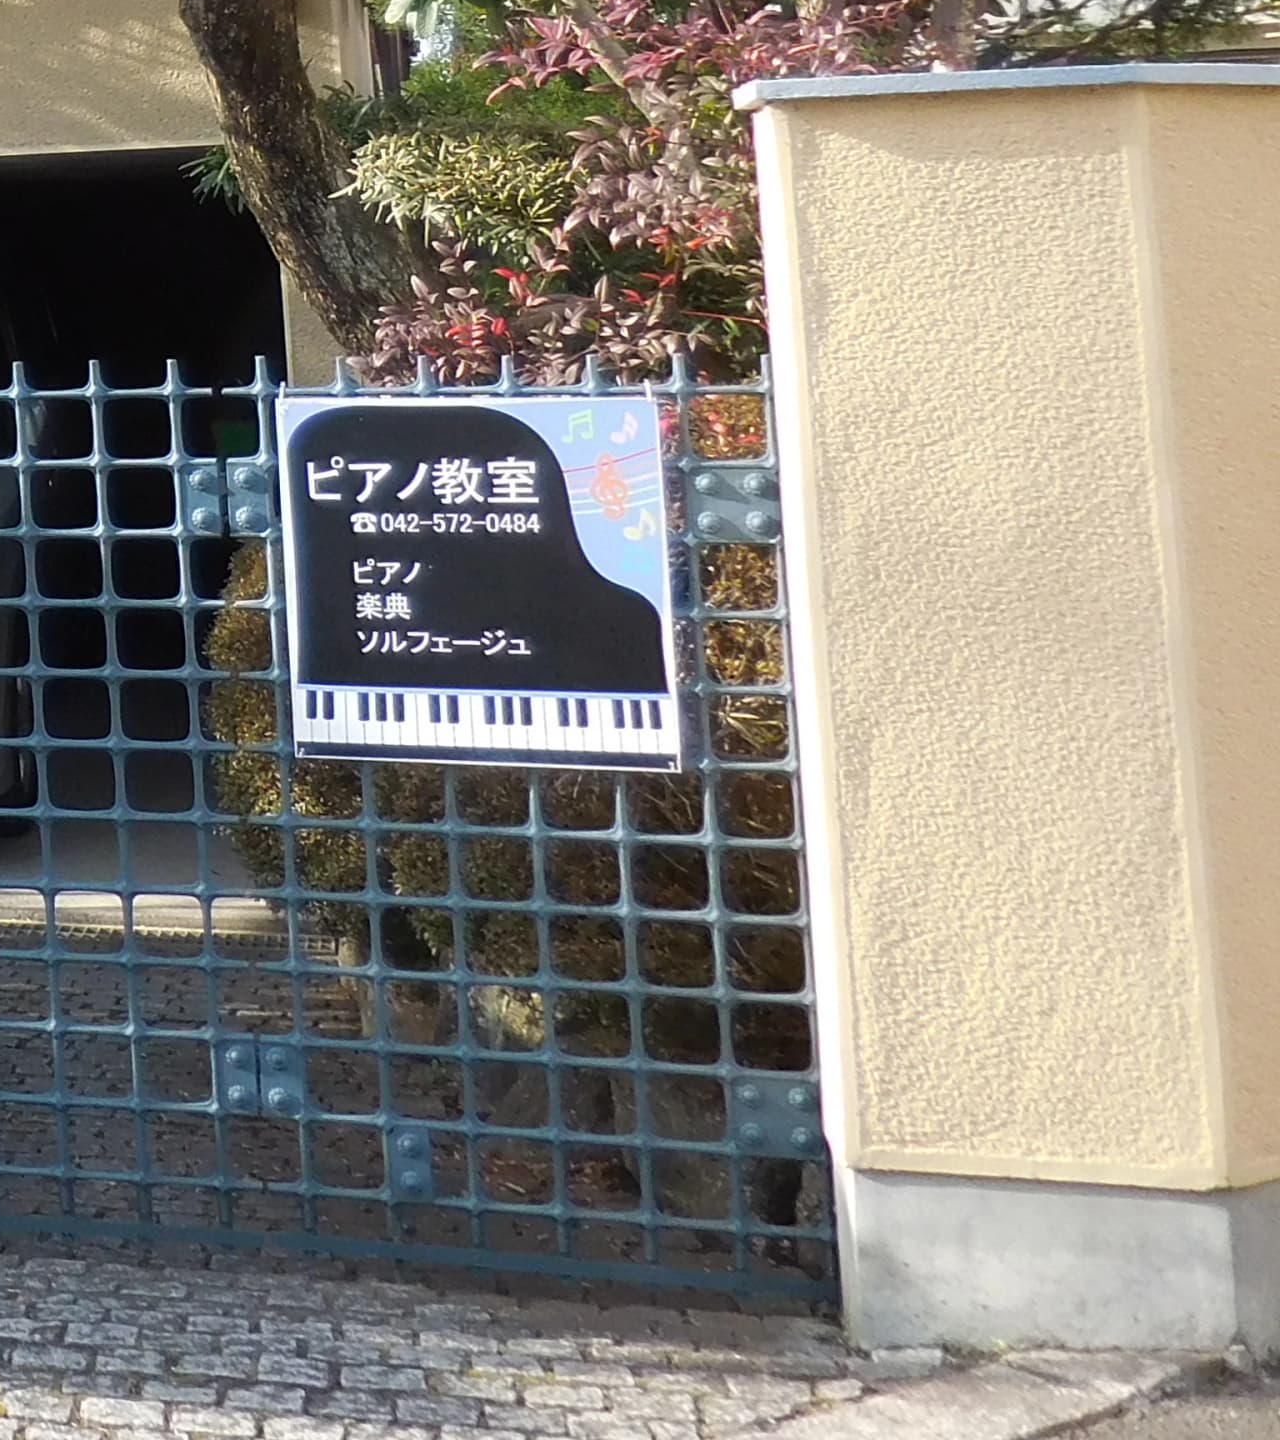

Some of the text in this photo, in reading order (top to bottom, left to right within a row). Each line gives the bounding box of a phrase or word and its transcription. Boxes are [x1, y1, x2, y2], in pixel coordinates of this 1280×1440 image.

[306, 455, 540, 504] ピアノ教室
[380, 513, 541, 533] 042-572-0484
[352, 558, 422, 585] ピアノ
[356, 592, 412, 620] 楽典
[356, 629, 532, 656] ソルフェージュ
